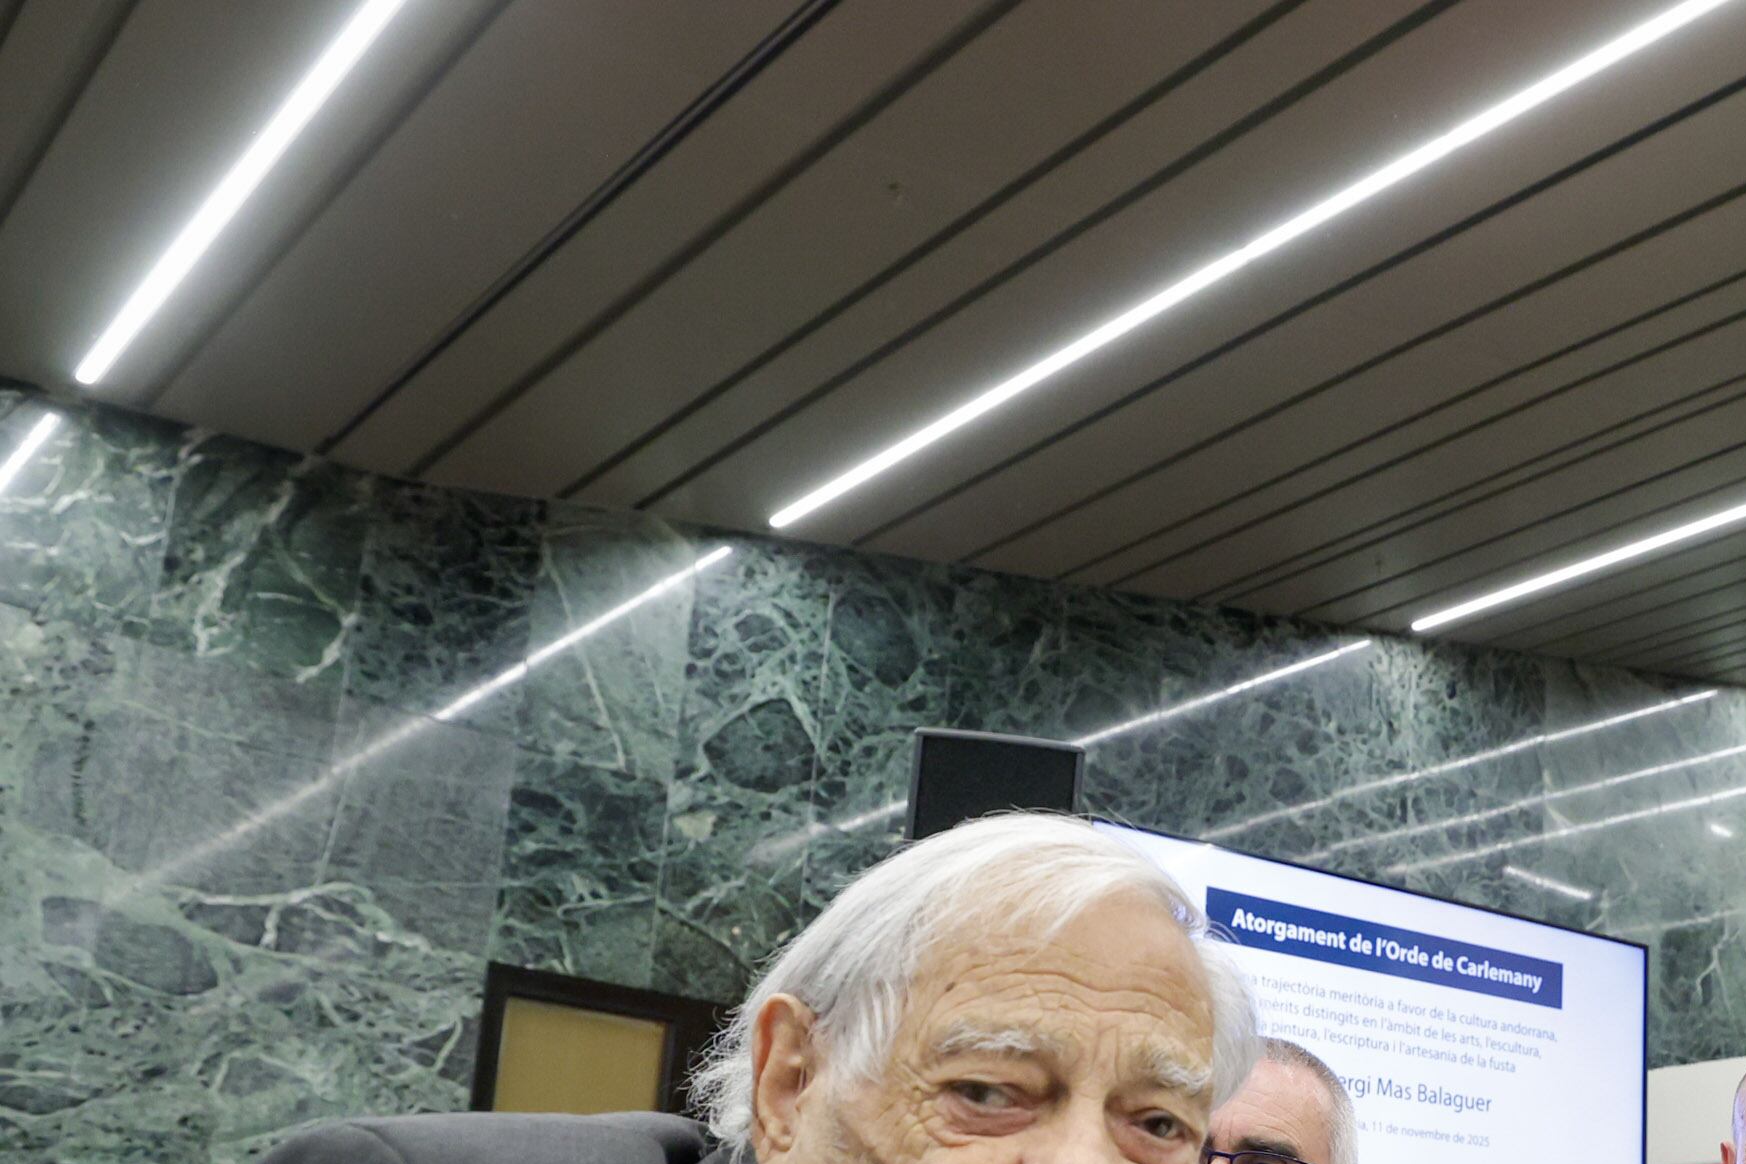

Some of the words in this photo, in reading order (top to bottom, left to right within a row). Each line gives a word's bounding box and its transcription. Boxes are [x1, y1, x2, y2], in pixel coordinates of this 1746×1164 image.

[1231, 908, 1346, 949] Atorgament
[1349, 933, 1373, 955] de
[1431, 951, 1454, 972] de
[1456, 956, 1543, 994] Carlemany
[1261, 975, 1326, 998] trajectòria
[1329, 988, 1385, 1009] meritòria
[1387, 1001, 1394, 1011] a
[1398, 1000, 1425, 1017] favor
[1429, 1006, 1444, 1021] de
[1447, 1009, 1457, 1023] la
[1459, 1013, 1498, 1030] cultura
[1500, 1021, 1558, 1042] andorrana,
[1303, 1004, 1360, 1026] distingits
[1363, 1017, 1378, 1029] en
[1424, 1026, 1438, 1039] de
[1441, 1028, 1457, 1043] les
[1459, 1033, 1483, 1048] arts,
[1271, 1022, 1321, 1041] pintura,
[1460, 1053, 1475, 1066] de
[1477, 1055, 1487, 1068] la
[1489, 1056, 1516, 1073] fusta
[1338, 1075, 1371, 1098] ergi
[1377, 1077, 1412, 1101] Mas
[1418, 1083, 1493, 1113] Balaguer
[1373, 1121, 1382, 1133] 11
[1386, 1123, 1398, 1136] de
[1401, 1127, 1450, 1143] novembre
[1452, 1132, 1465, 1145] de
[1467, 1134, 1490, 1148] 2025
